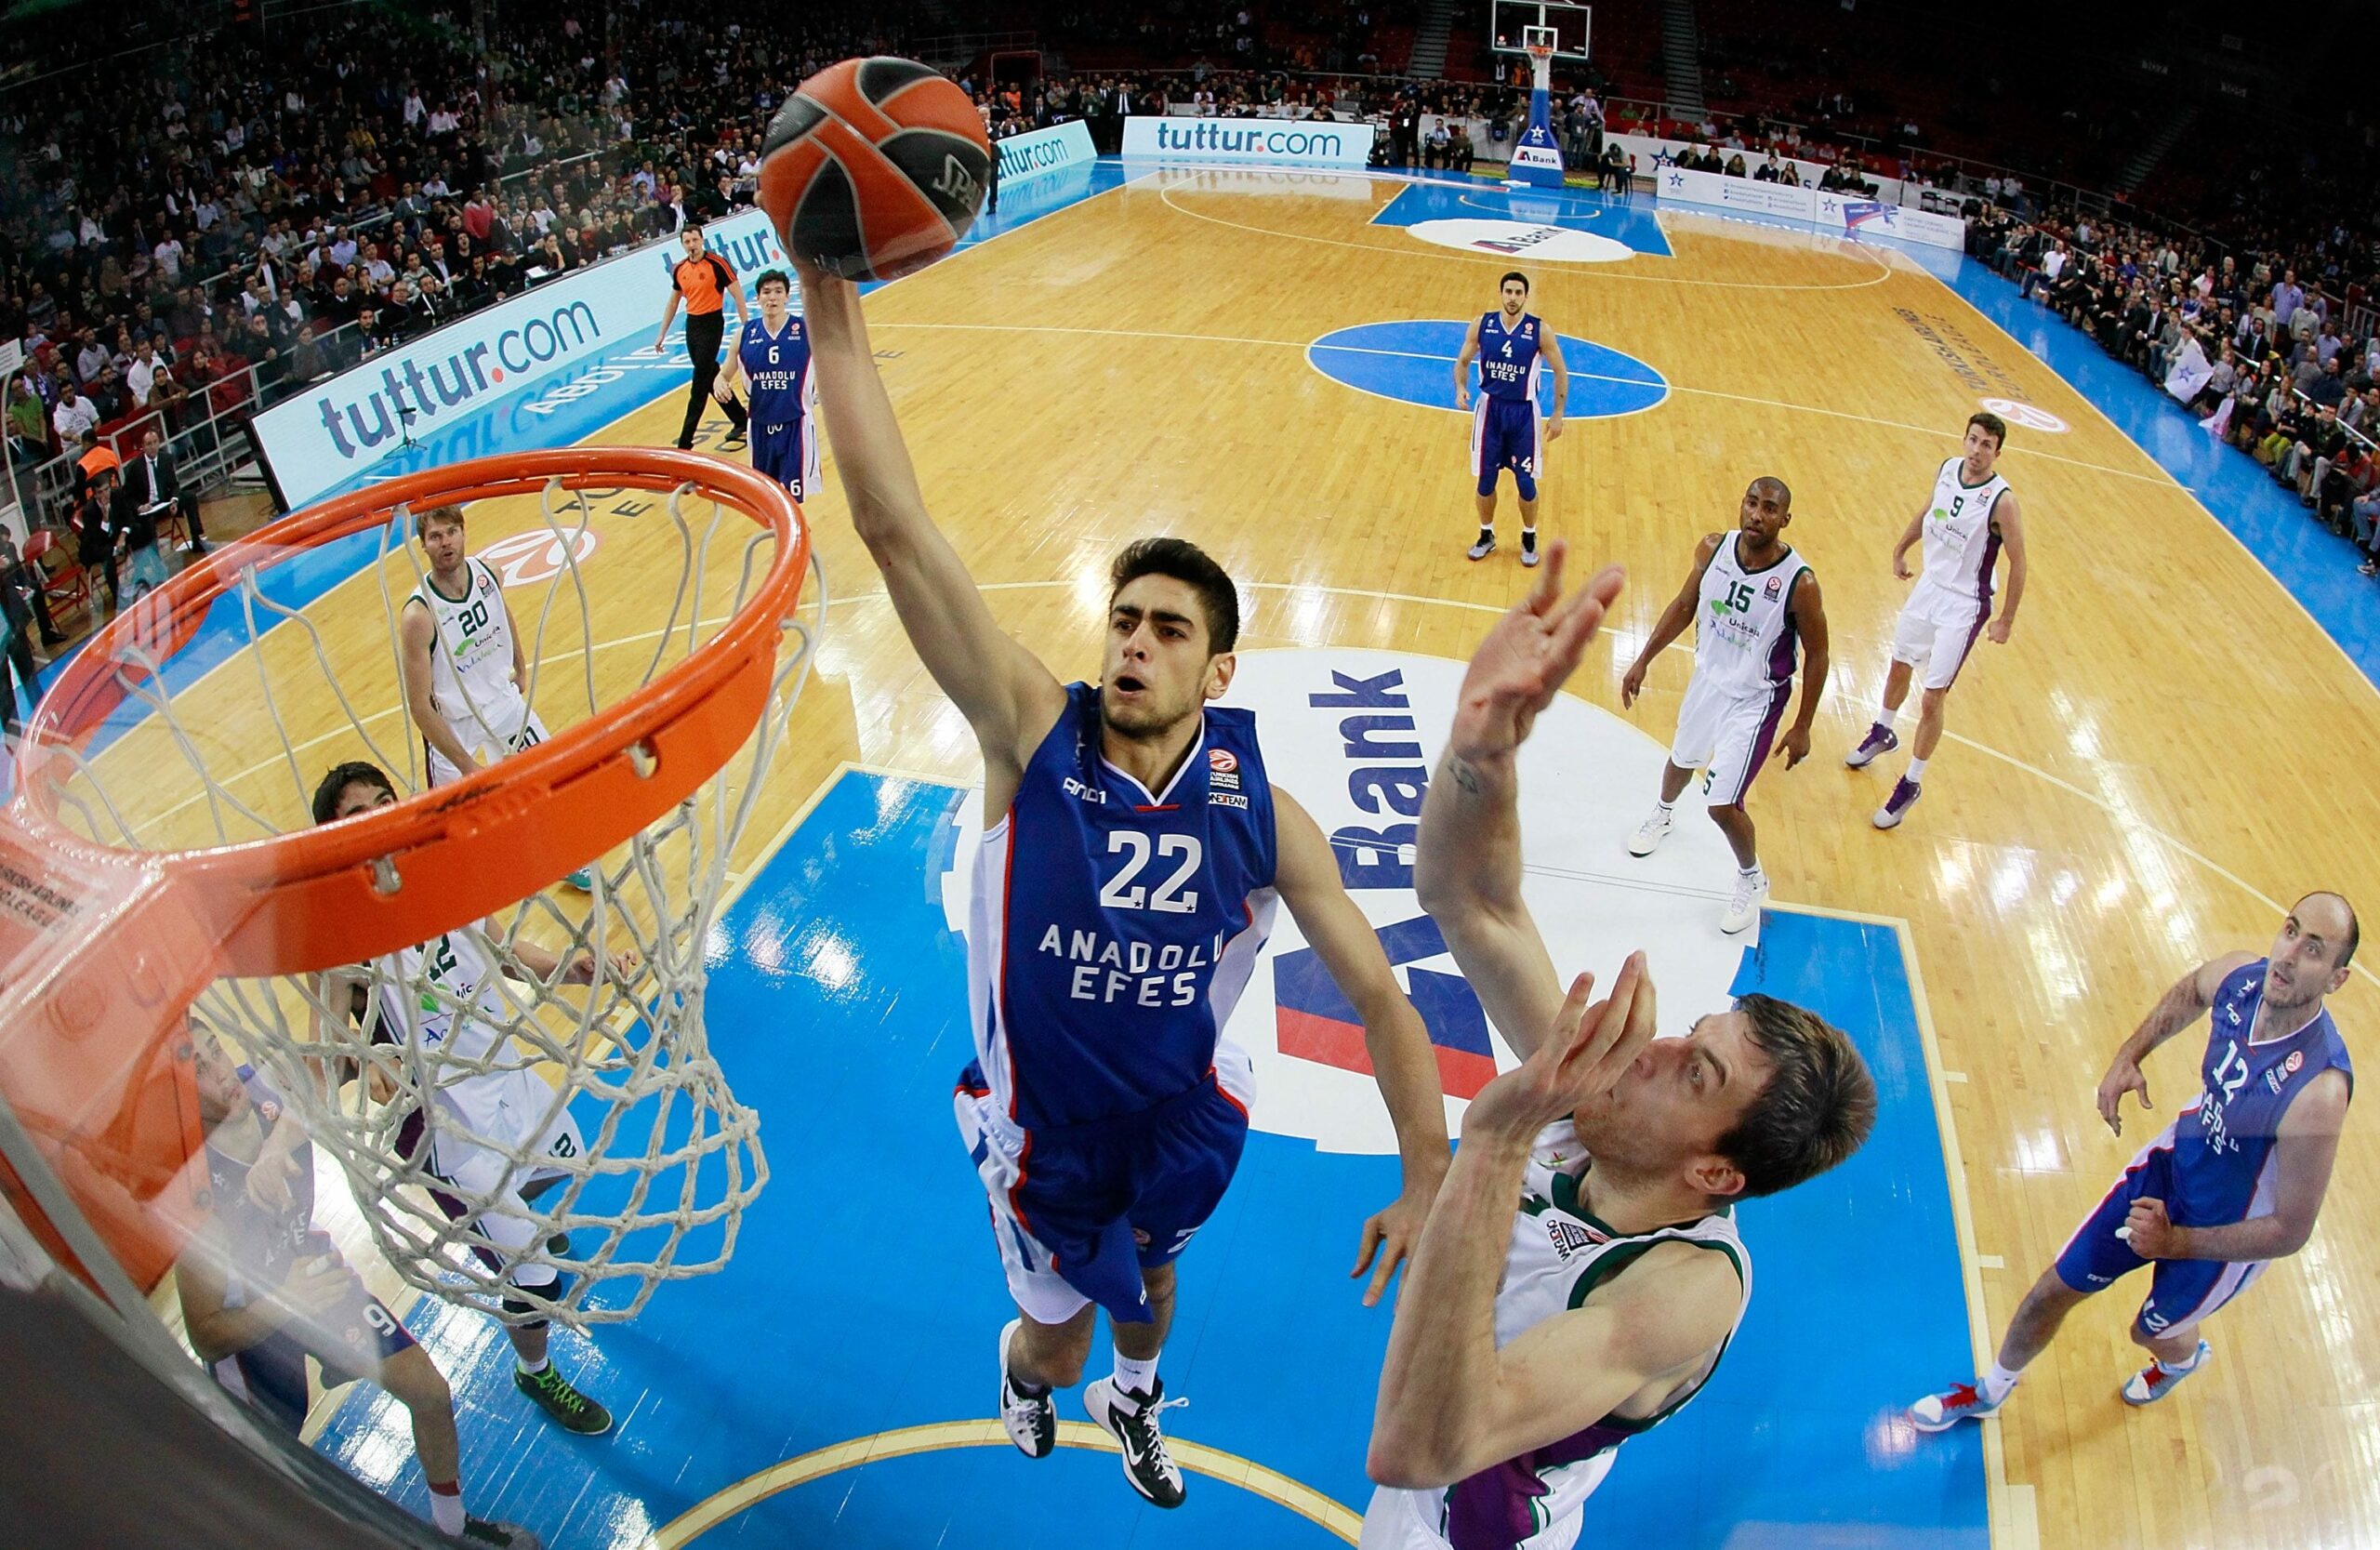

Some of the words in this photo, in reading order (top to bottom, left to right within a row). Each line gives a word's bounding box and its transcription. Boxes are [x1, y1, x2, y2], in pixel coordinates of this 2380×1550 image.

[1157, 122, 1341, 156] tuttur.com
[768, 346, 779, 364] 6
[1501, 340, 1513, 358] 4
[318, 300, 600, 458] tuttur.com
[752, 371, 796, 381] ANADOLU
[760, 380, 787, 390] EFES
[1521, 457, 1532, 472] 4
[790, 480, 801, 497] 6
[1950, 496, 1964, 517] 9
[1725, 580, 1755, 614] 15
[457, 600, 488, 638] 20
[1729, 617, 1760, 638] Unicaja
[1100, 830, 1202, 913] 22
[1038, 924, 1224, 974] ANADOLU
[1070, 966, 1197, 1007] EFES
[2213, 1040, 2249, 1105] 12
[549, 1133, 576, 1158] 2
[363, 1304, 397, 1337] 9
